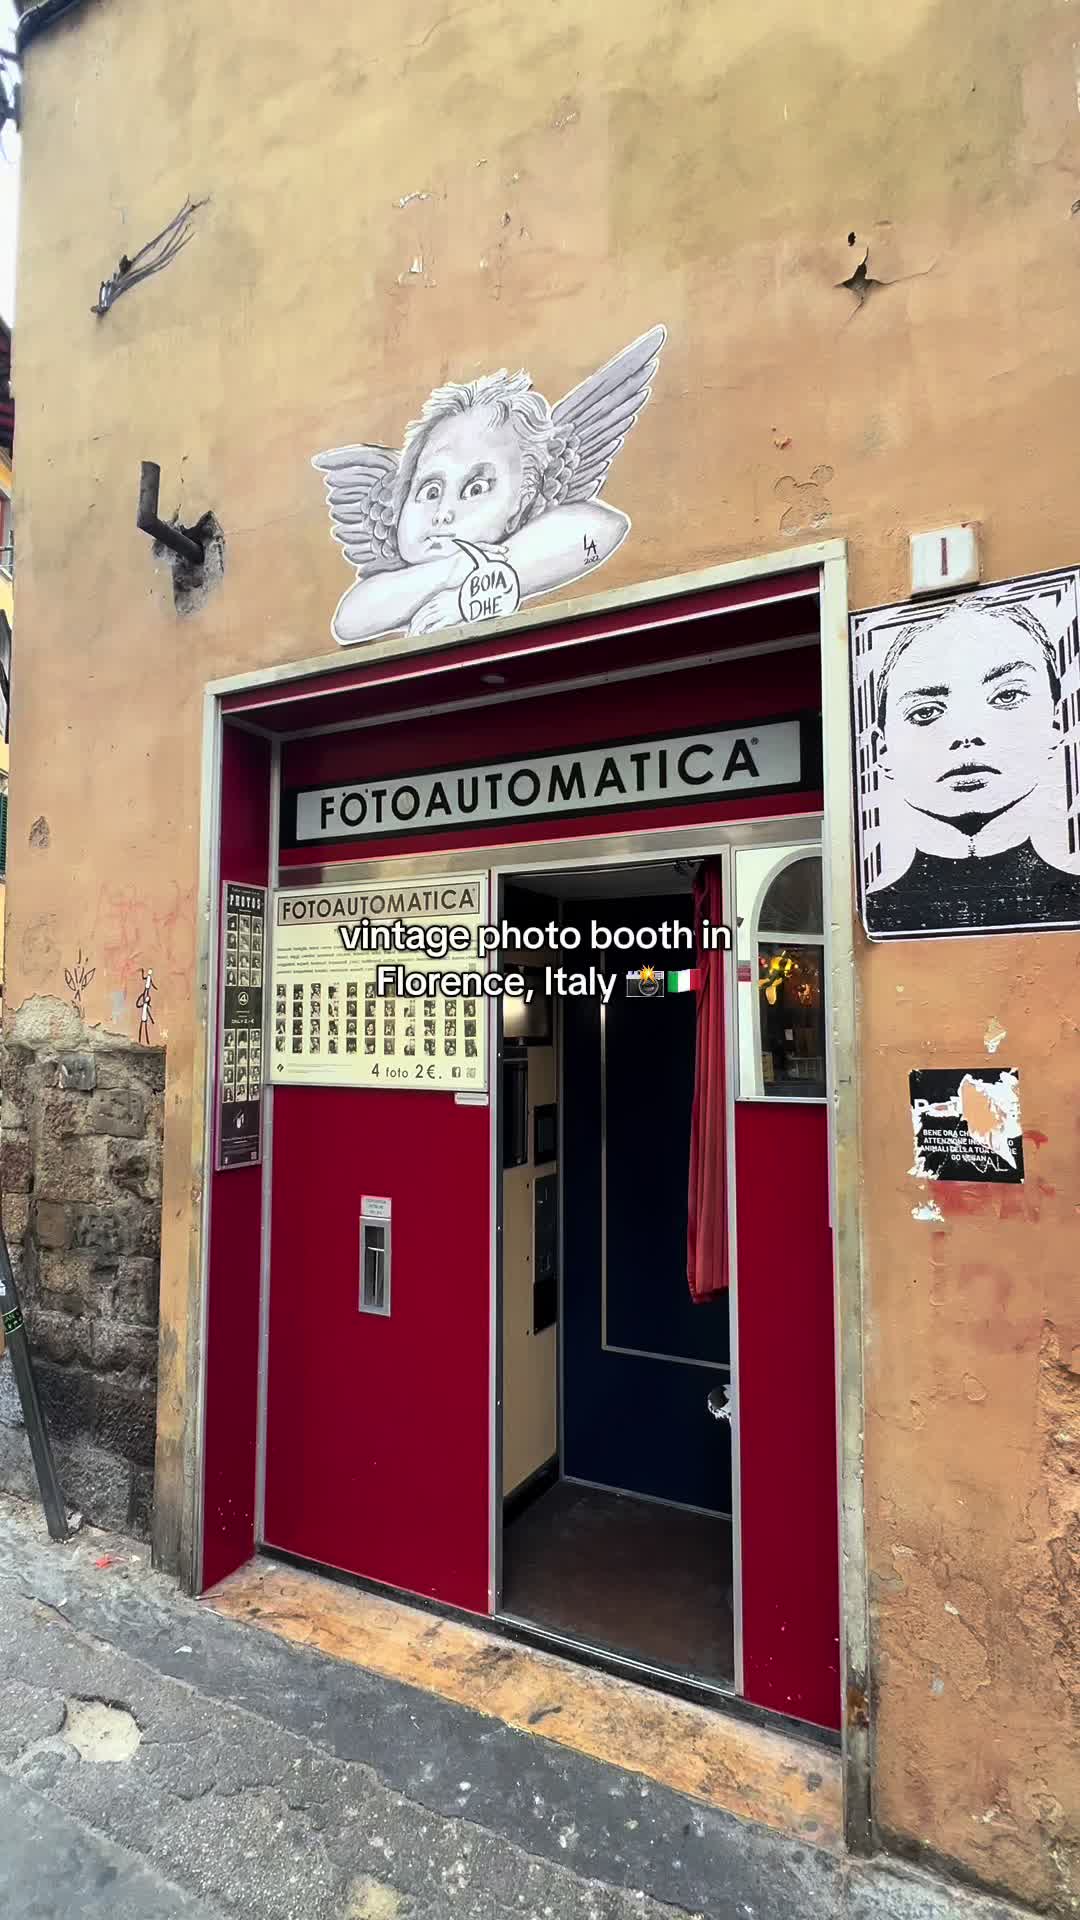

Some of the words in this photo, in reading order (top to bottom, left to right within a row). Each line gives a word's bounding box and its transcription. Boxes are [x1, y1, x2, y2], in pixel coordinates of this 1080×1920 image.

[469, 595, 503, 620] DHE
[371, 1063, 380, 1078] 4
[386, 1066, 409, 1078] foto
[923, 1129, 942, 1137] BENE
